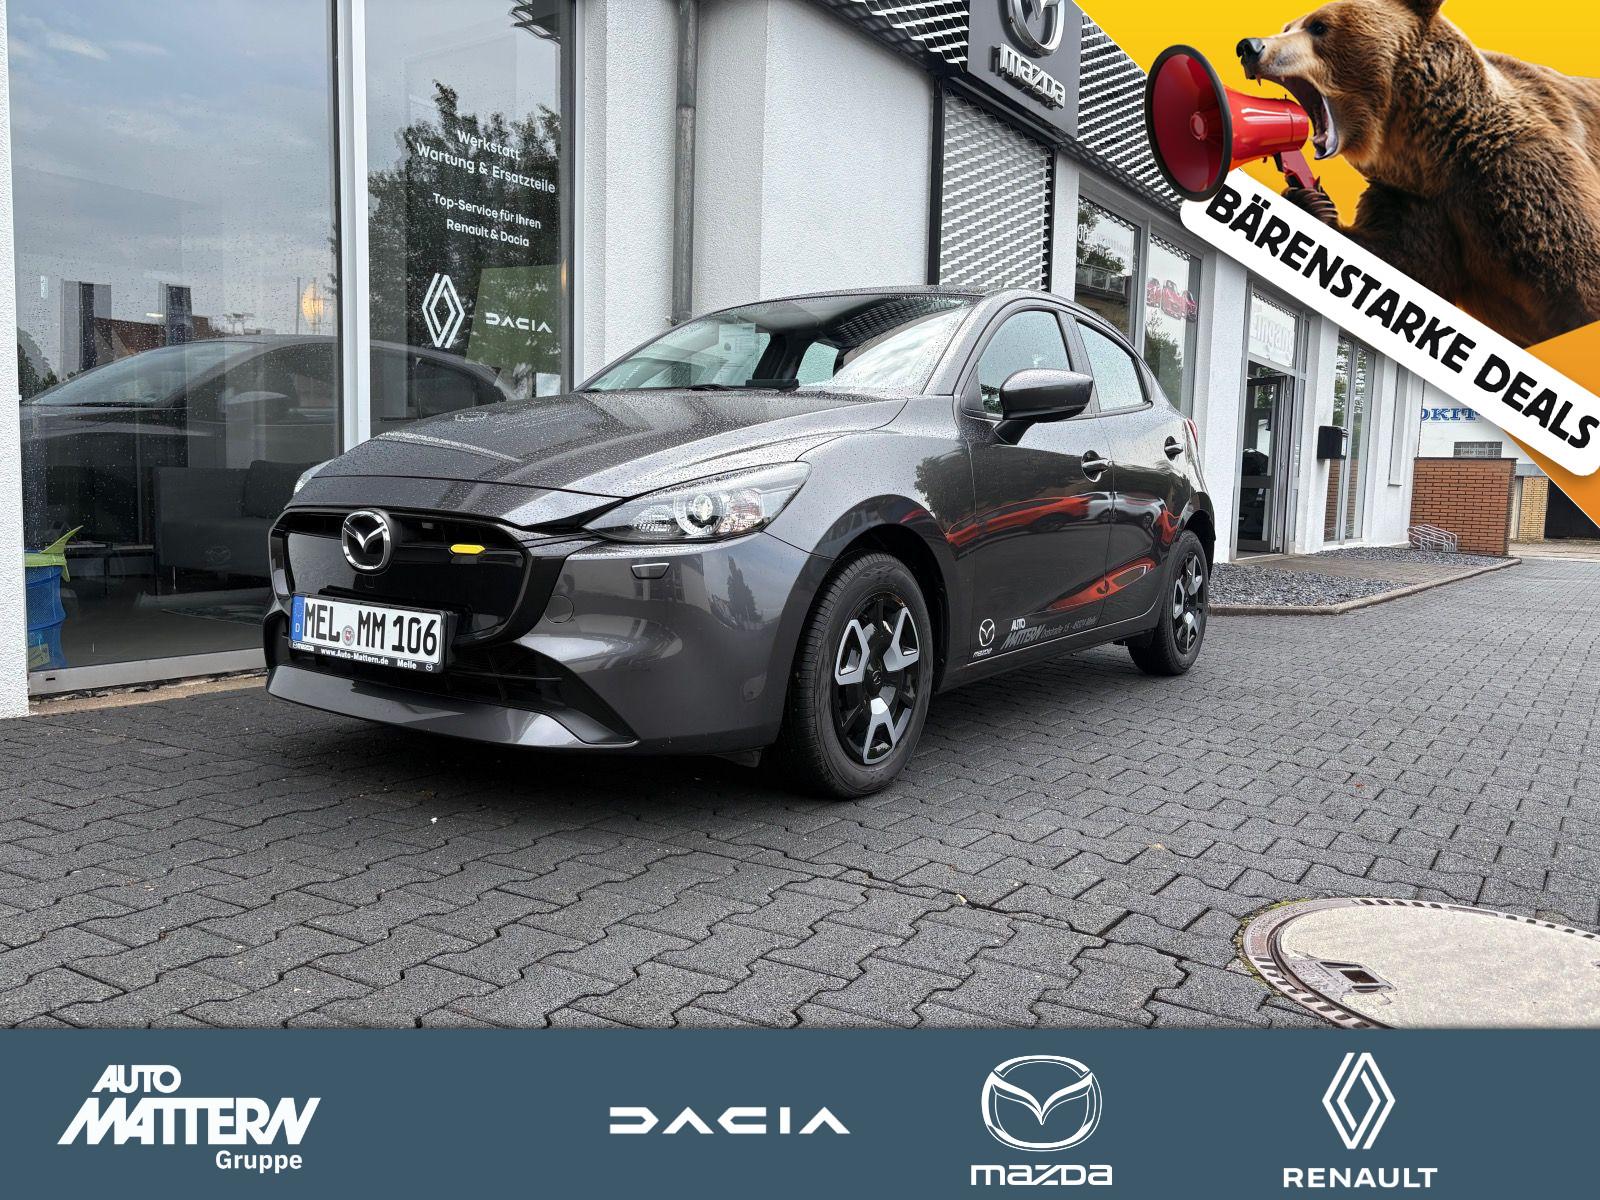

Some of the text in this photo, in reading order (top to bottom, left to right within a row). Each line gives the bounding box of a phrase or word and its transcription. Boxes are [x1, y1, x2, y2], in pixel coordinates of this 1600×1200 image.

[457, 130, 521, 160] Werkstatt
[416, 142, 556, 194] Wartung & Ersatzteile
[433, 192, 541, 229] Top-Service für Ihren
[446, 218, 530, 247] Renault & Dacia
[485, 312, 553, 334] DACIA
[295, 623, 300, 633] D
[304, 602, 437, 656] MEL MM 106
[1011, 618, 1026, 632] AUTO
[320, 648, 389, 666] www.Auto-Mattern.de
